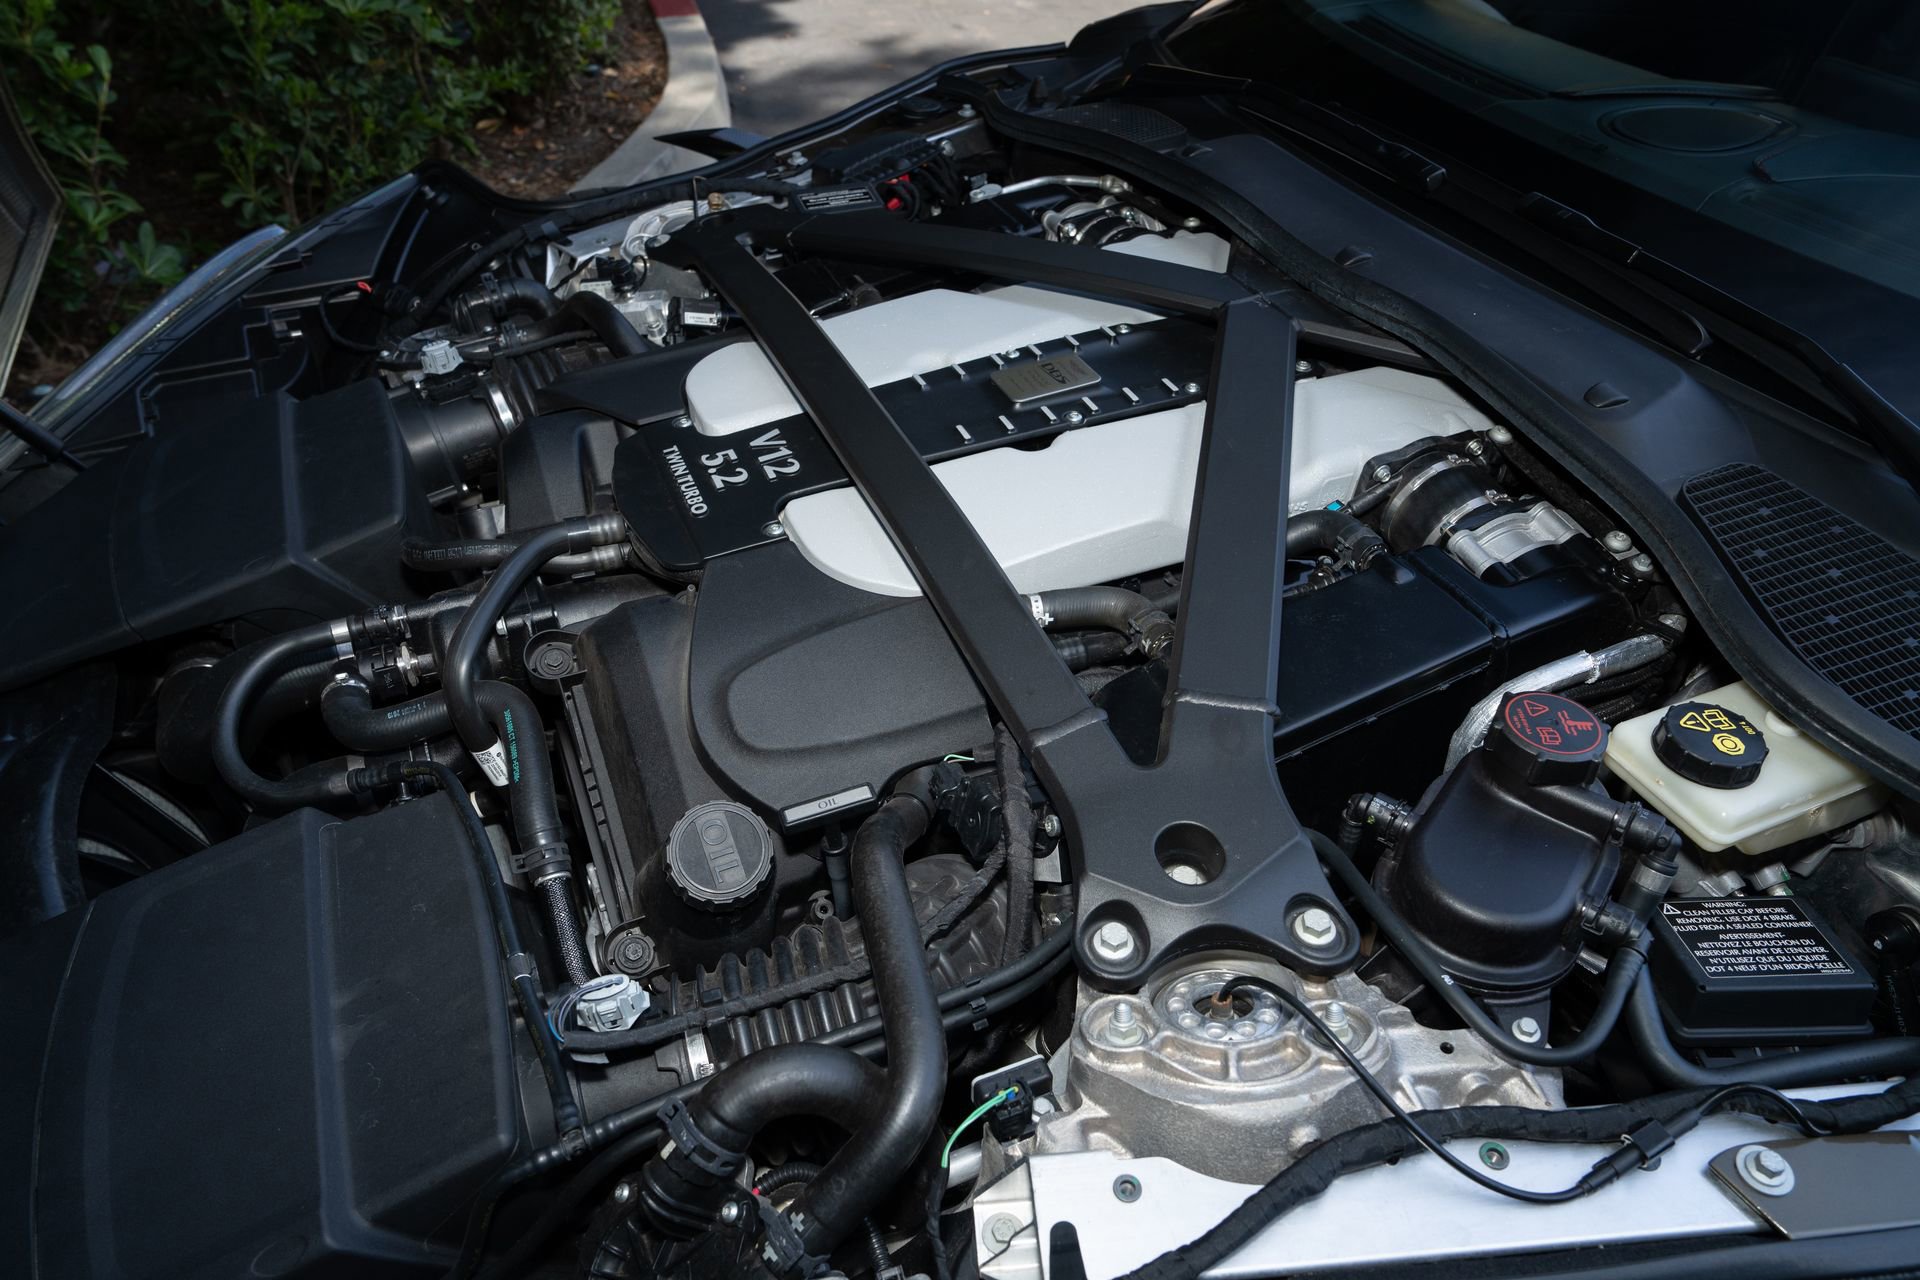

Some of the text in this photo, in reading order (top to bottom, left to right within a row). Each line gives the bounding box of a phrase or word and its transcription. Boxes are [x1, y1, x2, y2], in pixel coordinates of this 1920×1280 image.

[749, 428, 800, 480] V12
[700, 448, 749, 490] 5.2
[818, 798, 837, 810] OIL
[701, 818, 740, 883] OIL
[1682, 909, 1710, 917] CLEAN
[1711, 908, 1737, 916] FILLER
[1737, 907, 1754, 915] CAP
[1733, 922, 1763, 930] SEALED
[1697, 941, 1742, 949] NETTOYEZ
[1752, 939, 1800, 947] BOUCHON
[1694, 949, 1741, 957] RESERVOIR
[1742, 947, 1770, 955] AVANT
[1708, 956, 1756, 965] N'UTILISEZ
[1756, 955, 1777, 964] QUE
[1793, 954, 1830, 963] LIQUIDE
[1705, 965, 1726, 973] DOT
[1733, 964, 1758, 972] NEUF
[1759, 963, 1784, 971] D'UN
[1814, 961, 1846, 969] SCELLE
